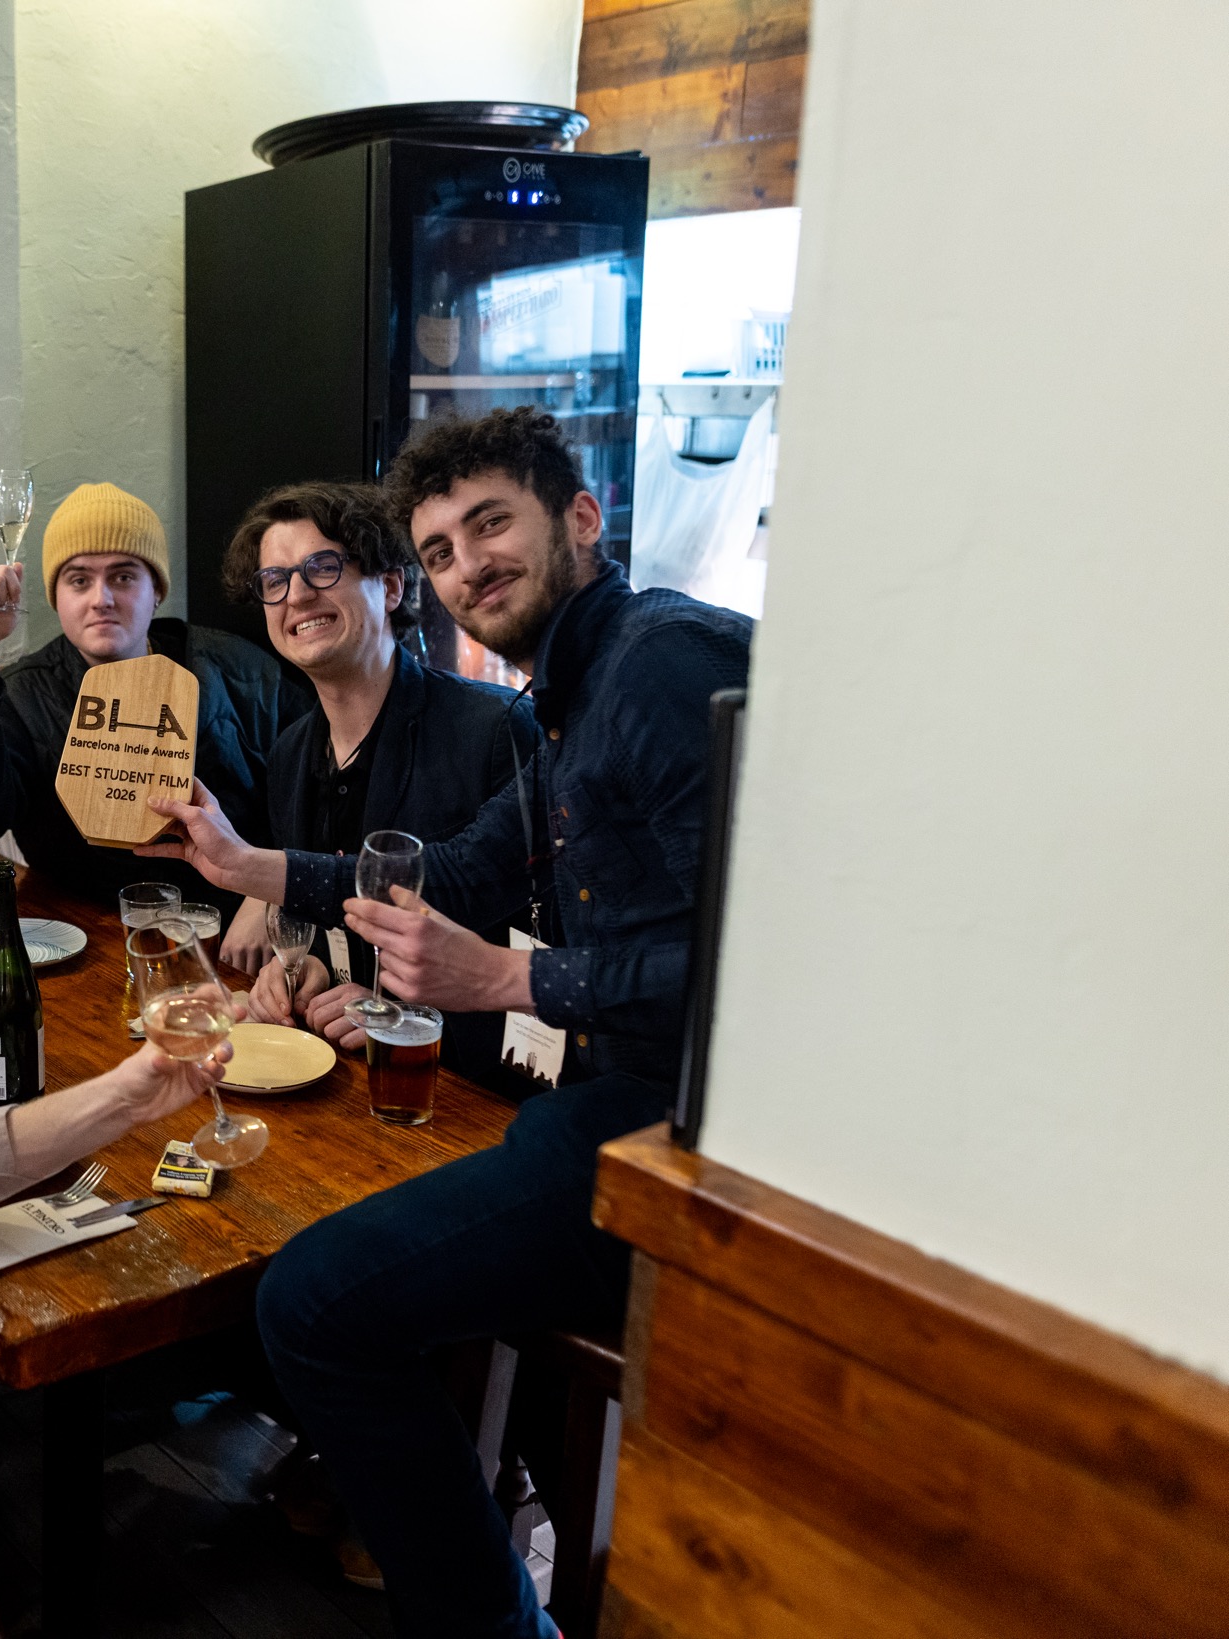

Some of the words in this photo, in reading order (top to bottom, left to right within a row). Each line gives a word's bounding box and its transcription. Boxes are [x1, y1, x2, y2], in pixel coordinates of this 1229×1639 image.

[70, 737, 120, 752] Barcelona
[124, 743, 149, 755] Indie
[151, 746, 190, 760] Awards
[60, 763, 91, 777] BEST
[94, 767, 155, 785] STUDENT
[159, 774, 190, 789] FILM
[105, 787, 136, 801] 2026
